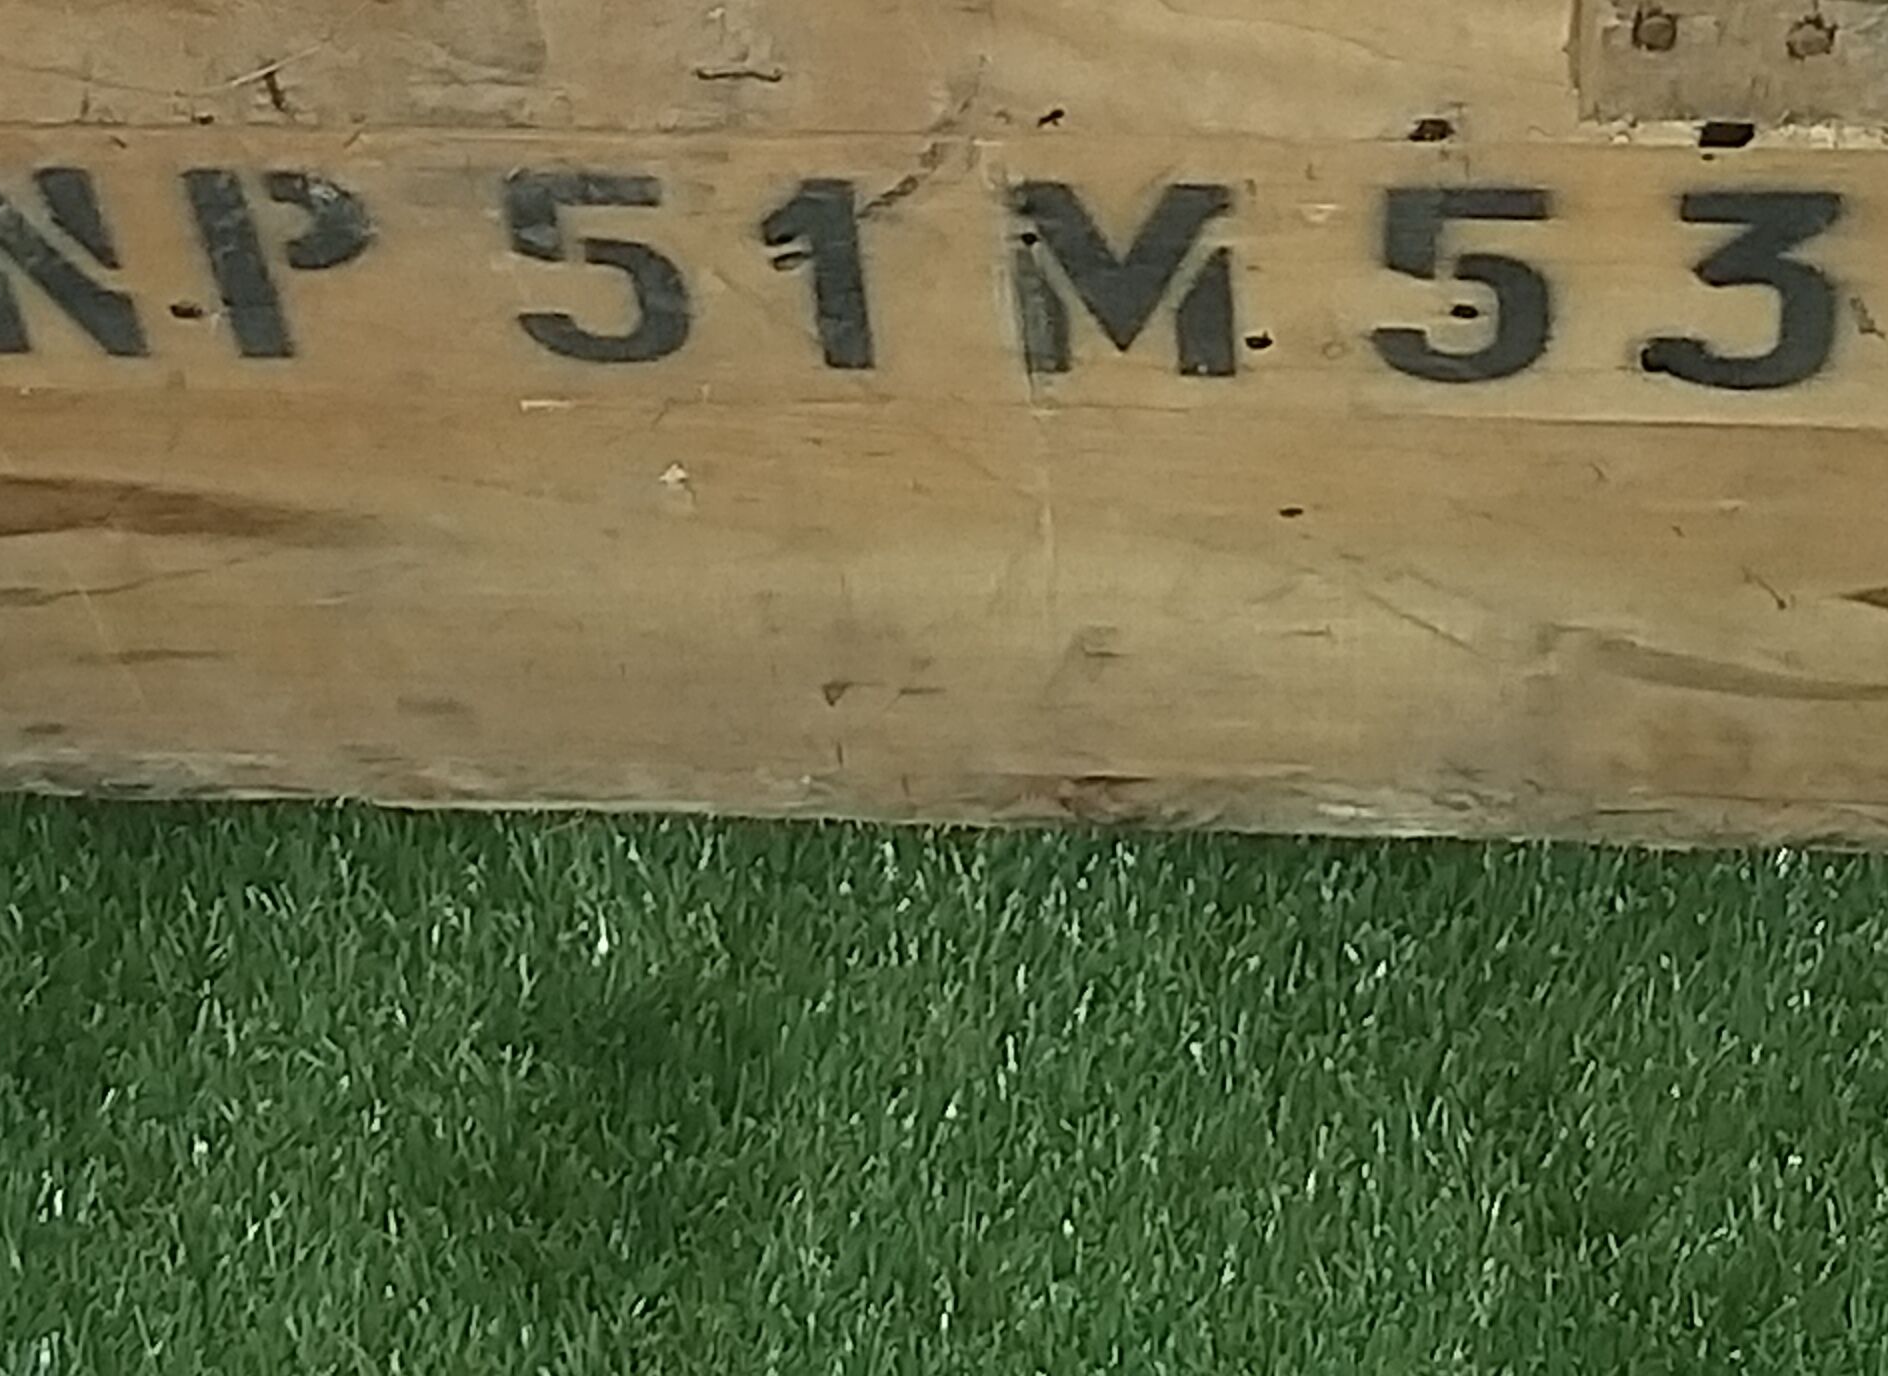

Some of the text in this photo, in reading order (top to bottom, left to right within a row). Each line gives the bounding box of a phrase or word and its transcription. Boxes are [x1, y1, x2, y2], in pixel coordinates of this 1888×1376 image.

[504, 171, 878, 372] 51
[1004, 179, 1240, 380] M
[1369, 185, 1850, 392] 53
